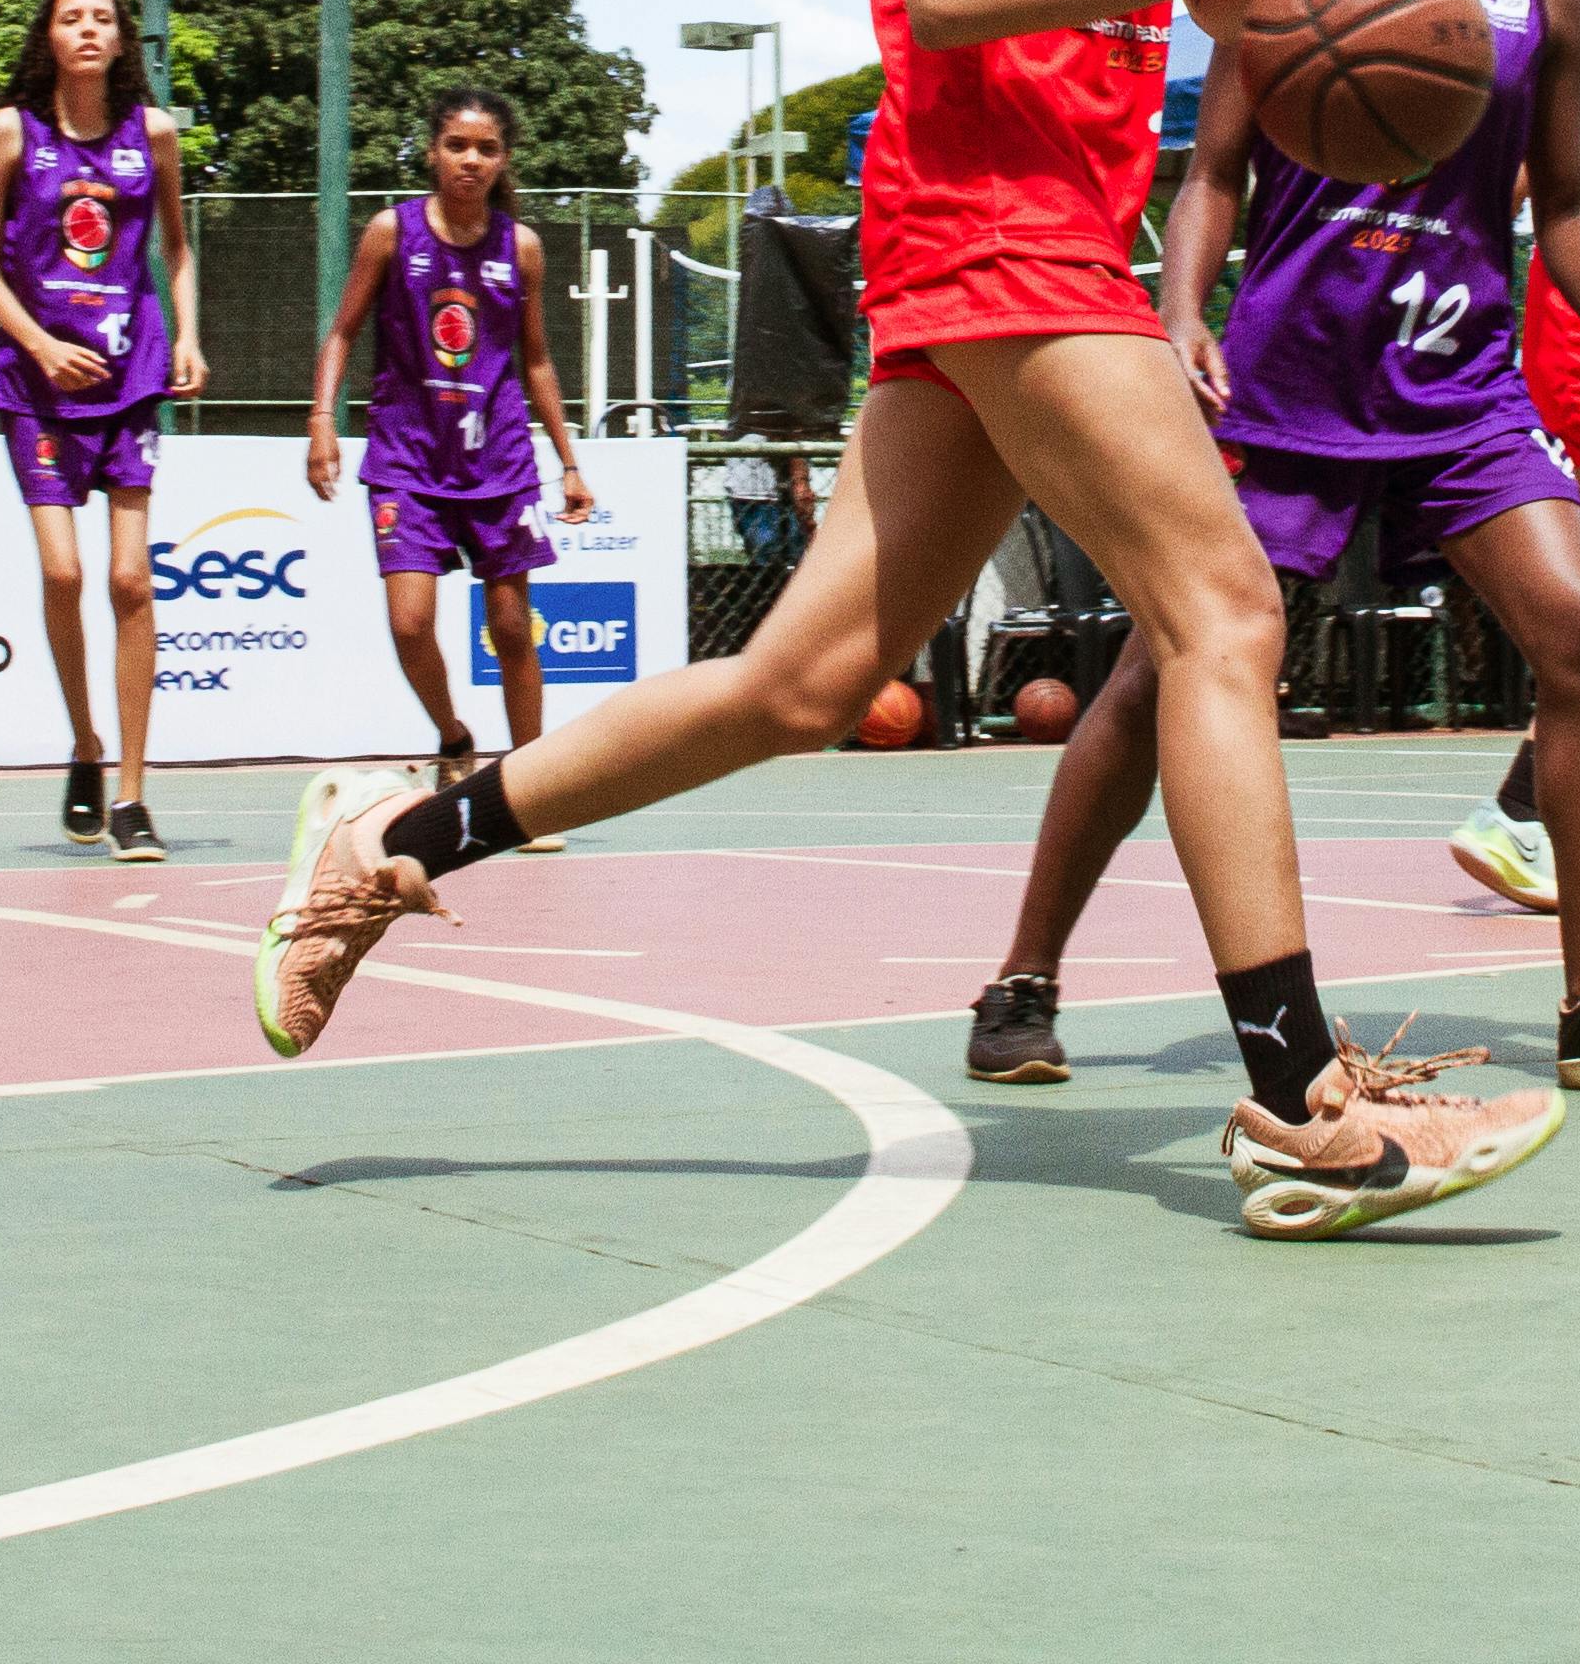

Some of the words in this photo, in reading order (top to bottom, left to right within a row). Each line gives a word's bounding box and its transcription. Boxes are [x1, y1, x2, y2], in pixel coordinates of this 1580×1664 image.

[1390, 270, 1470, 356] 12
[578, 531, 639, 551] Lazer
[156, 623, 307, 651] ecomércio
[548, 620, 628, 653] GDF
[155, 667, 230, 691] enac
